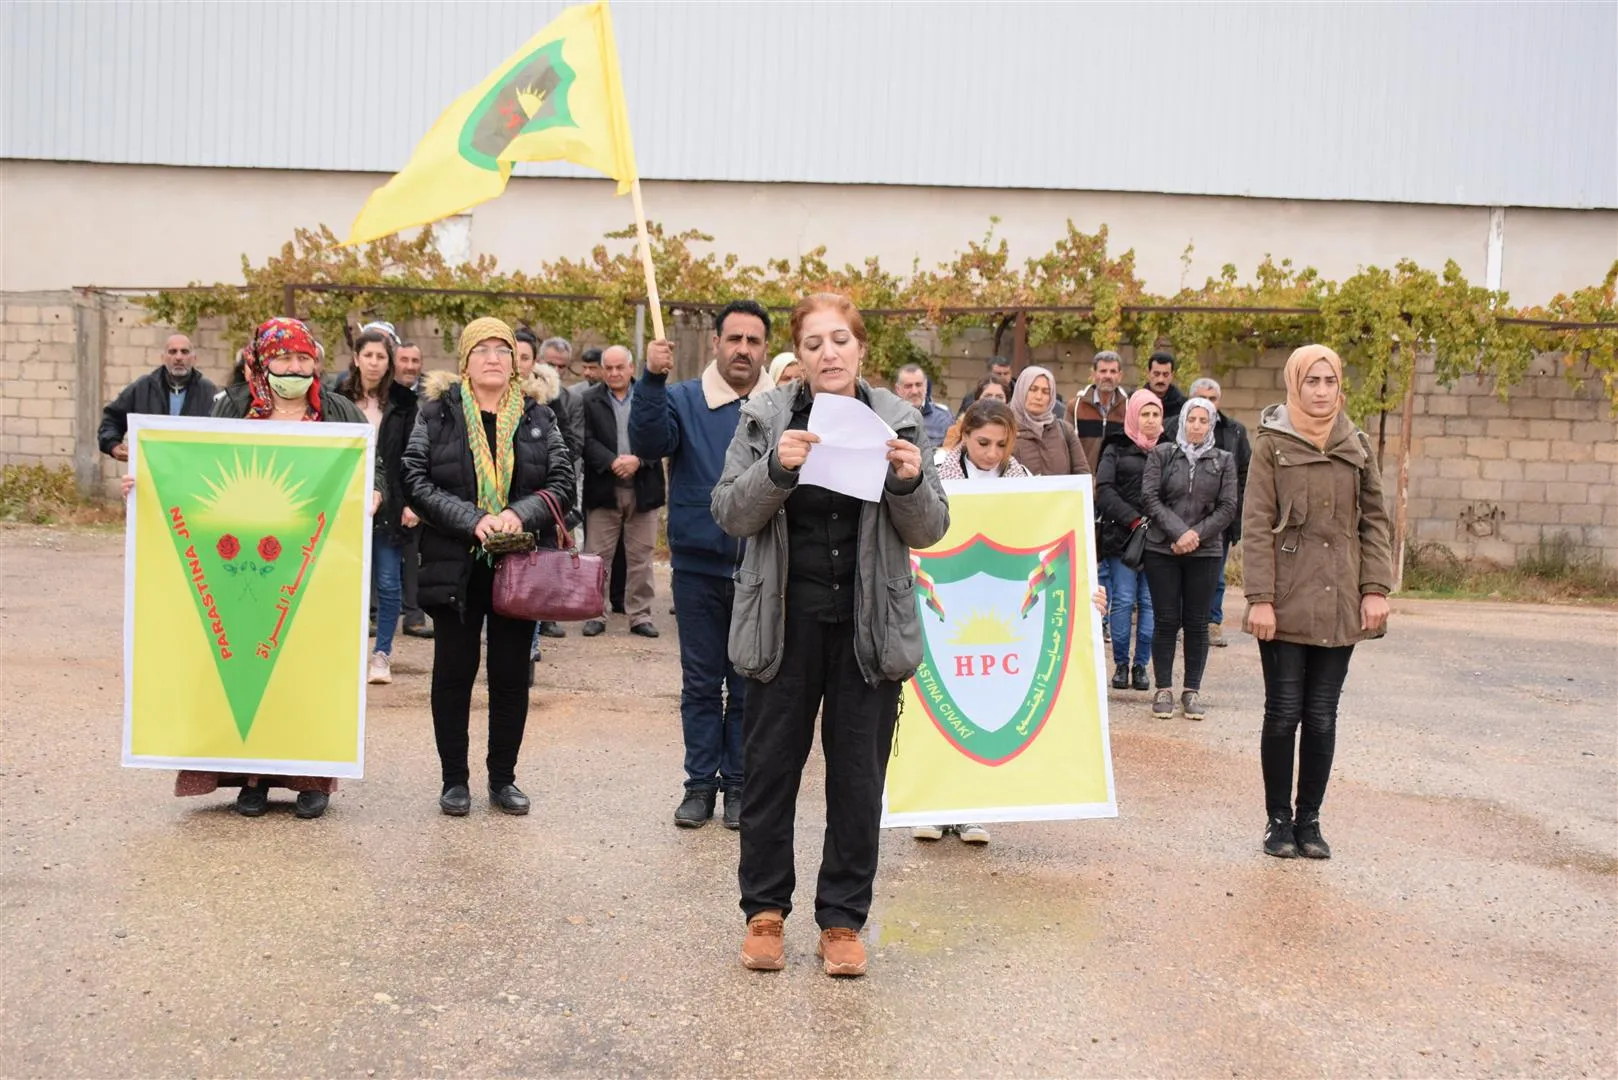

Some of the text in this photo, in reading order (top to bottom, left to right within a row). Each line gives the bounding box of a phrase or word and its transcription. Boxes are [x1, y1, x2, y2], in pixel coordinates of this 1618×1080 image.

[1052, 589, 1067, 627] قوات
[953, 653, 1020, 677] HPC
[1037, 629, 1061, 682] حماية
[917, 662, 944, 703] ASTINA
